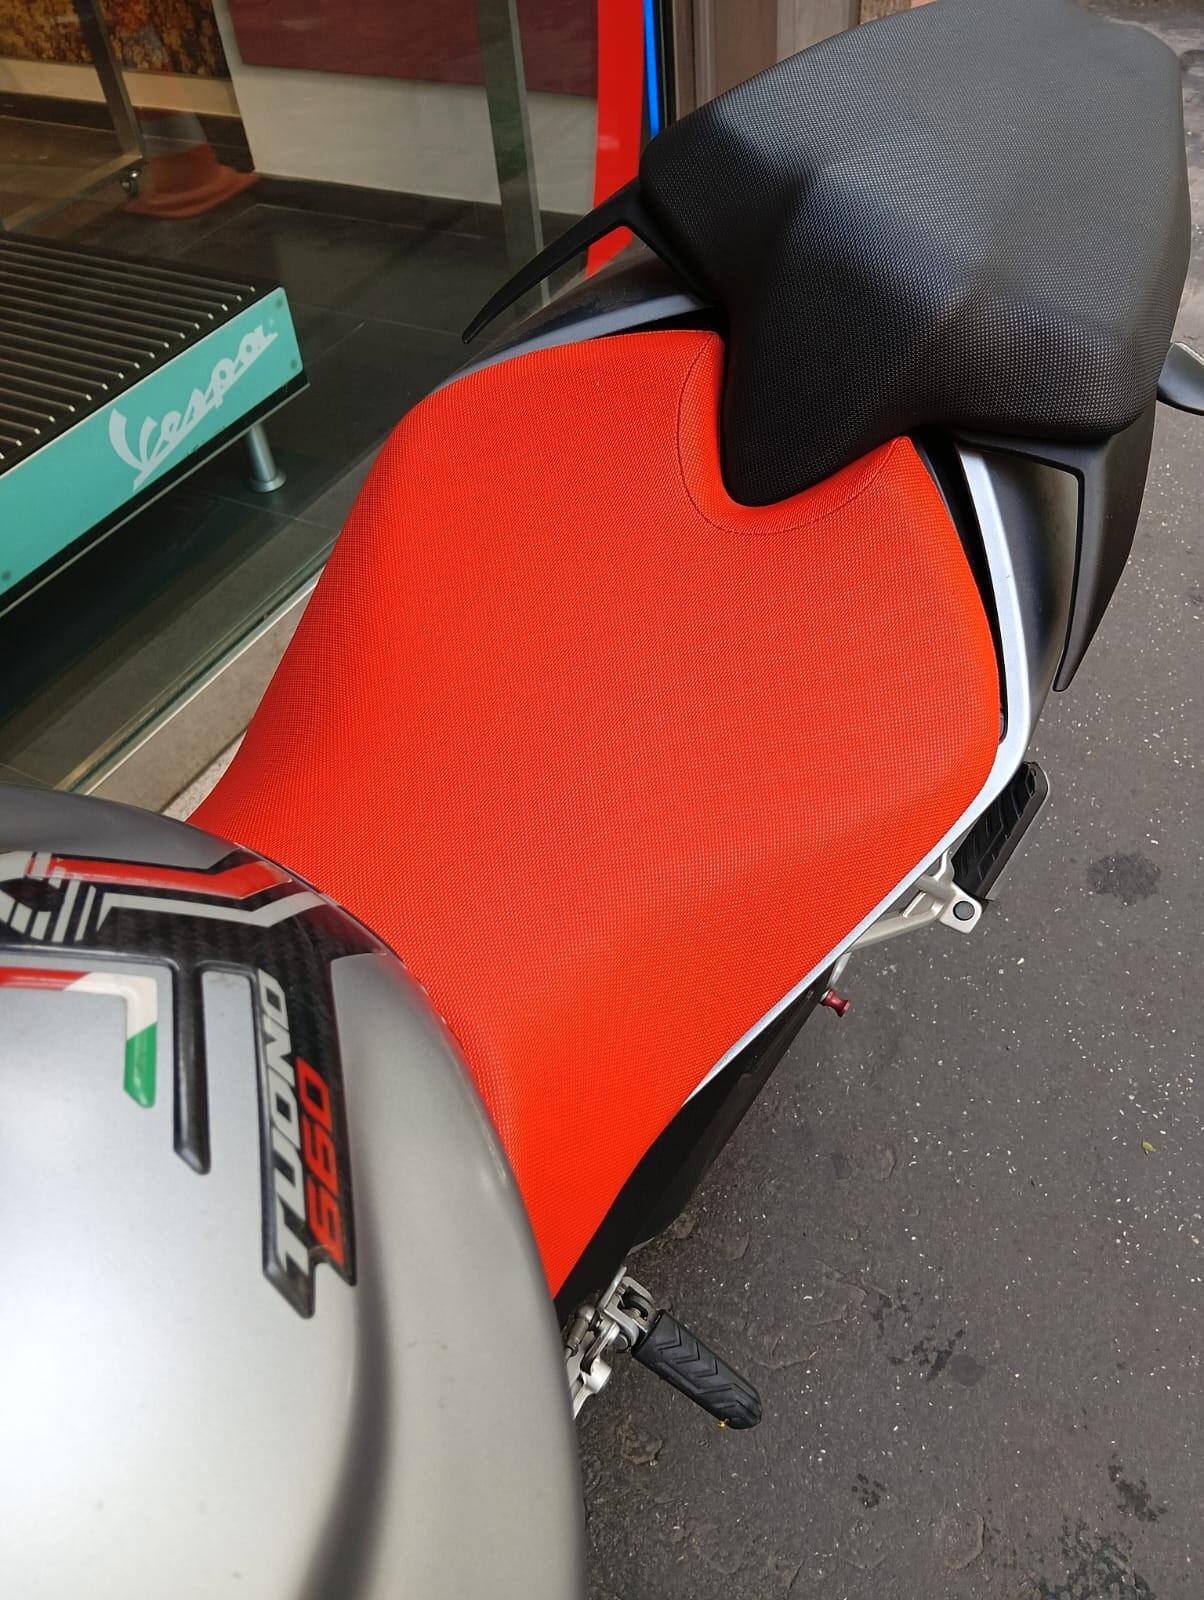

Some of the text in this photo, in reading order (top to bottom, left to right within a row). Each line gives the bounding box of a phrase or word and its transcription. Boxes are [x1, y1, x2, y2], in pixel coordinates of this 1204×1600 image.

[109, 325, 278, 490] Vespa
[257, 969, 310, 1276] TUONO
[296, 1057, 344, 1265] 660
